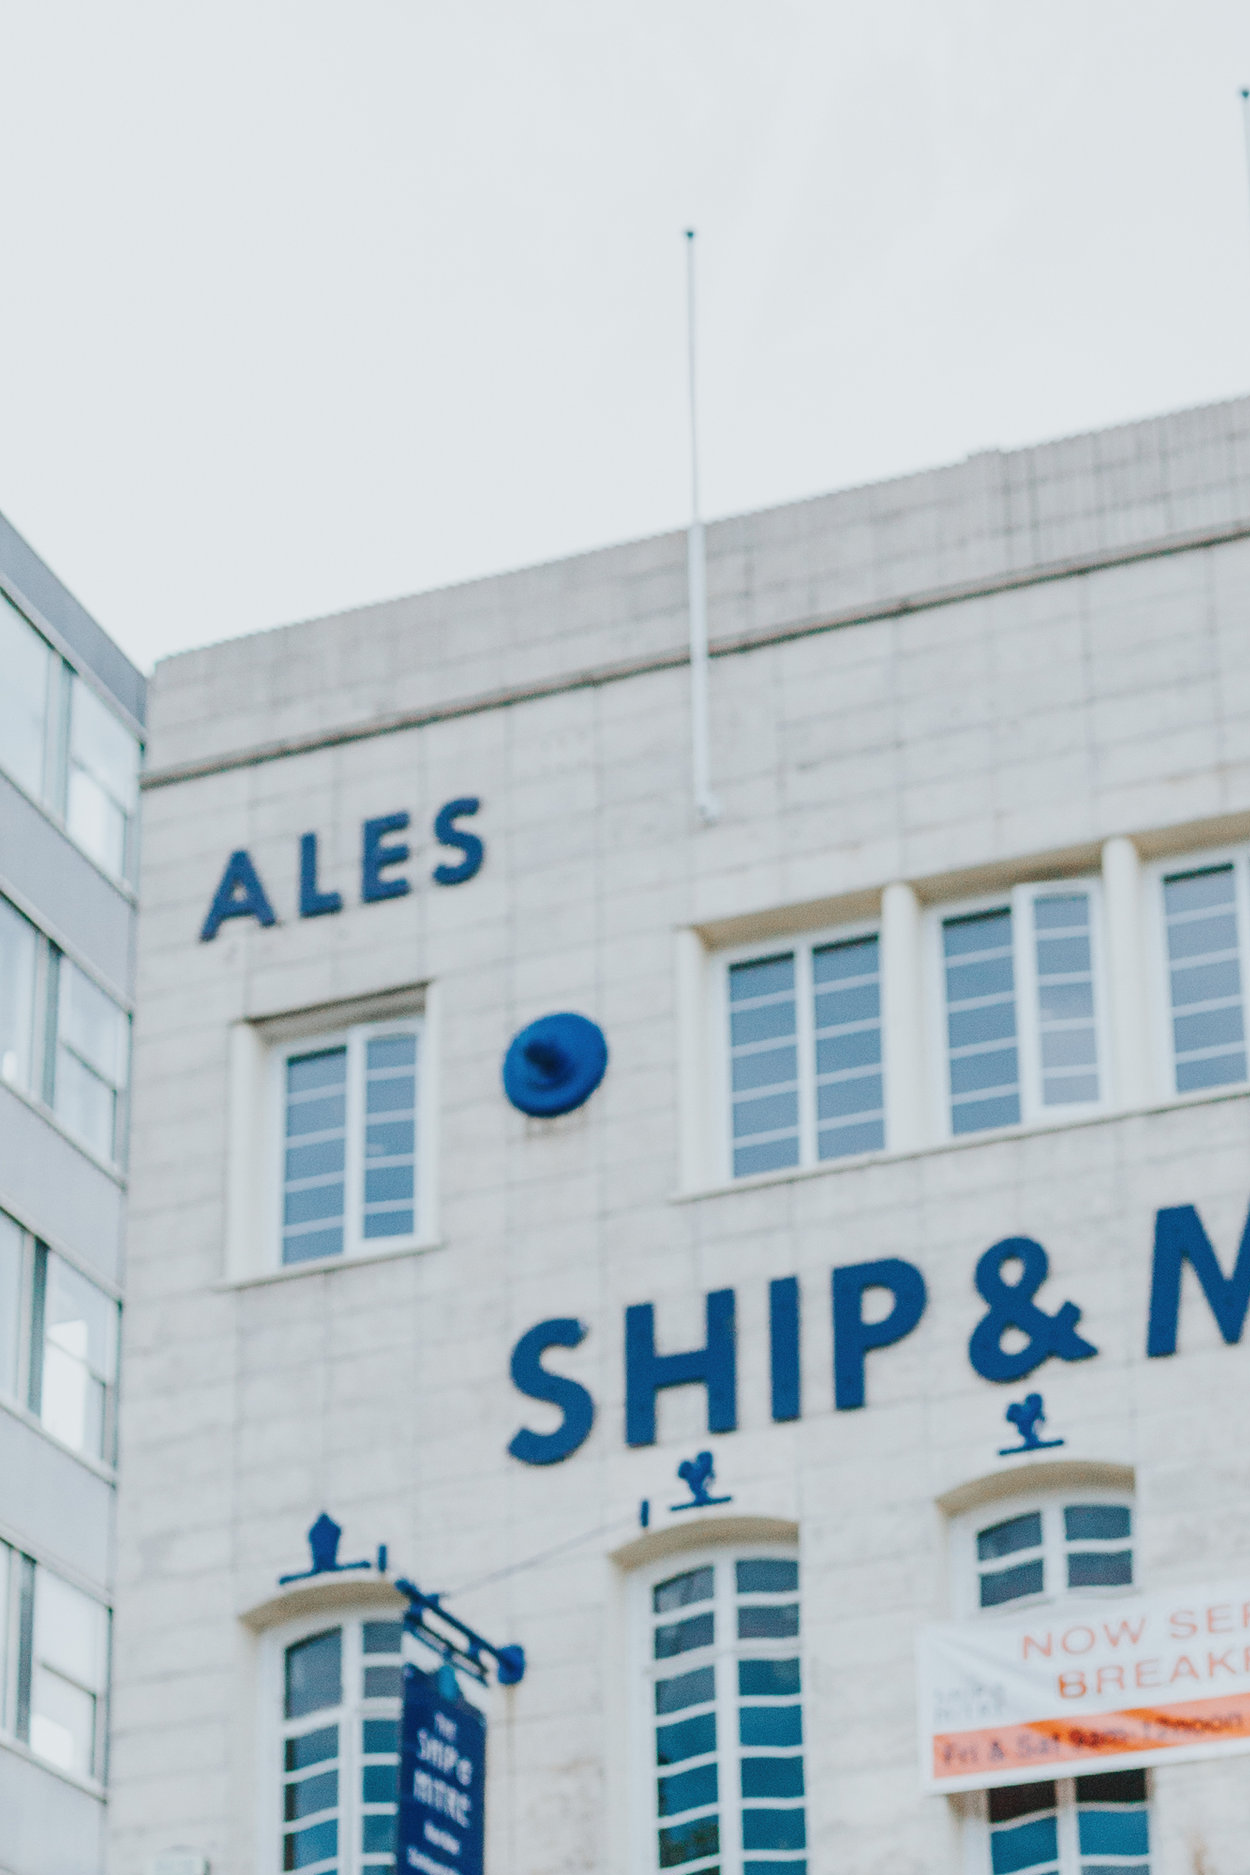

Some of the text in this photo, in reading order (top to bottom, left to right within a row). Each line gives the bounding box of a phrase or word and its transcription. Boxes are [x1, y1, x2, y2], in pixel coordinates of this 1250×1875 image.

[200, 796, 486, 941] ALES
[506, 1257, 929, 1467] SHIP
[967, 1235, 1099, 1383] &
[1022, 1617, 1146, 1661] NOW
